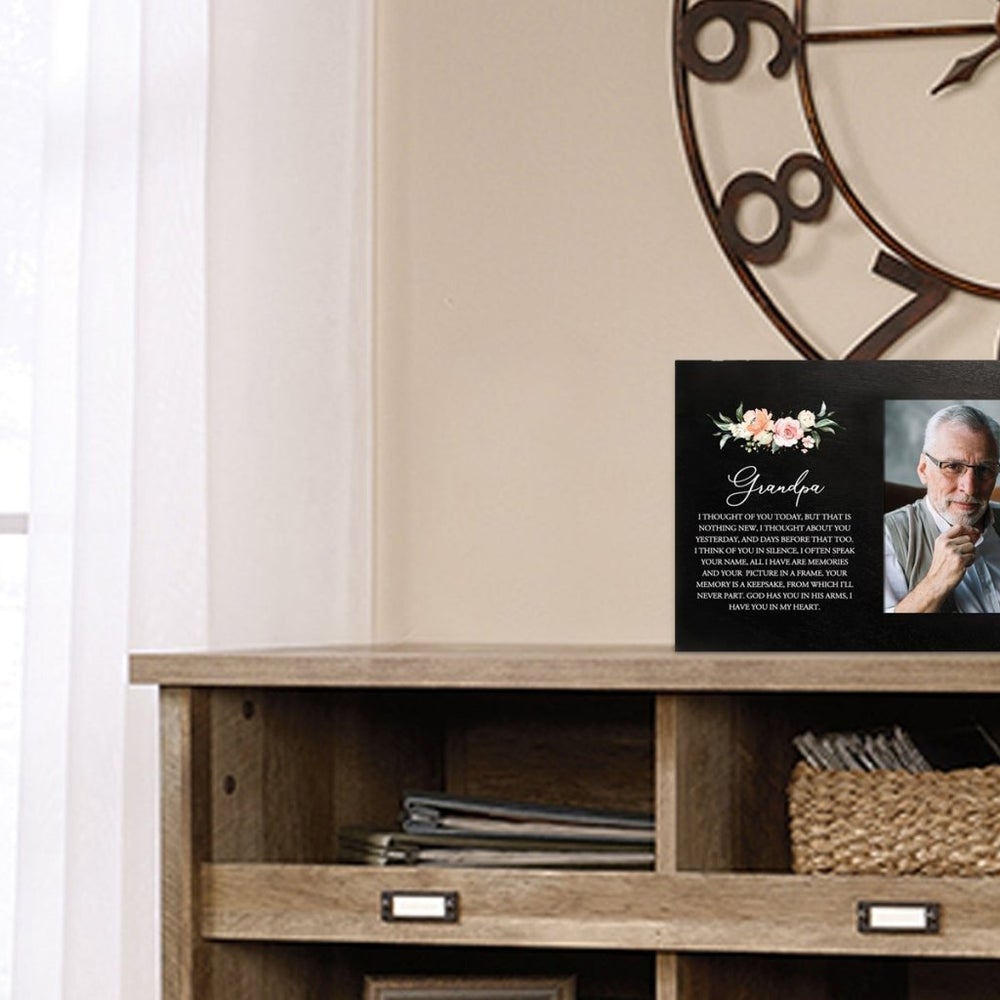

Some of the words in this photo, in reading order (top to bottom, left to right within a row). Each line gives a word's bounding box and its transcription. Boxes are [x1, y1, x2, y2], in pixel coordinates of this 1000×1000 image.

[720, 152, 833, 264] 8
[845, 250, 950, 360] 7
[726, 465, 826, 508] Grandpa
